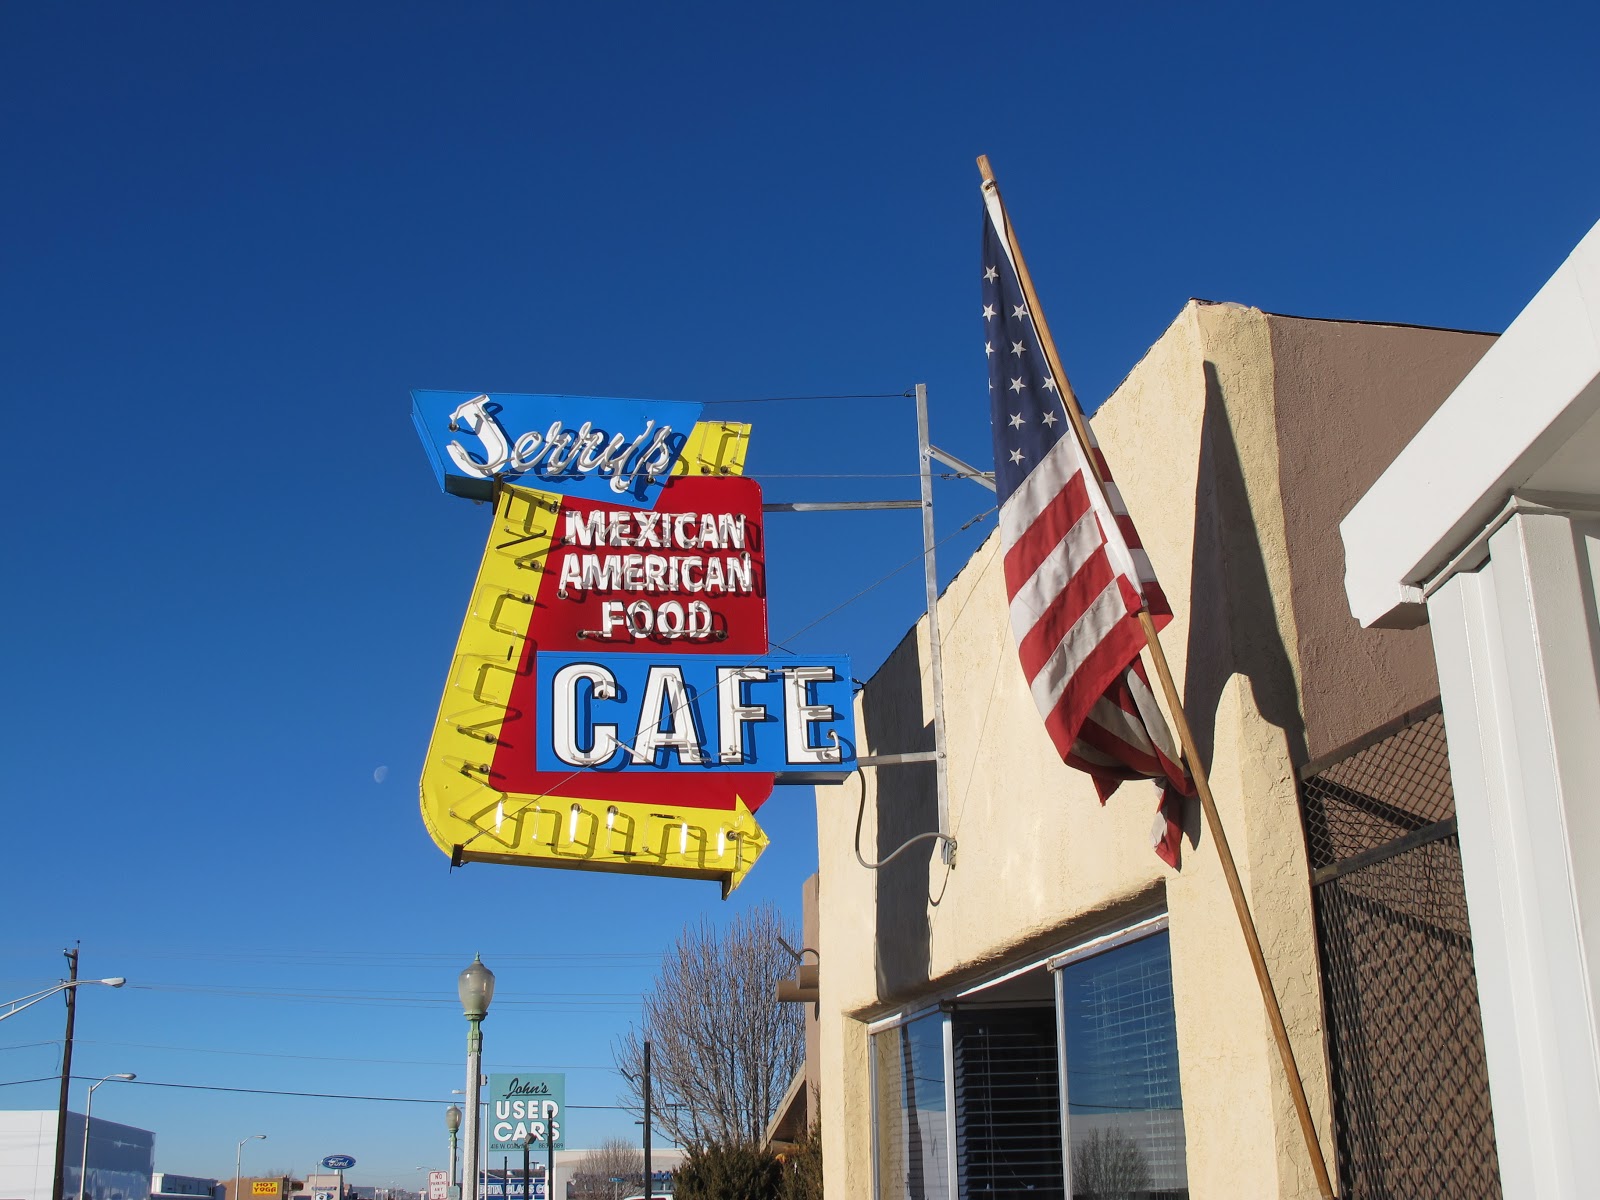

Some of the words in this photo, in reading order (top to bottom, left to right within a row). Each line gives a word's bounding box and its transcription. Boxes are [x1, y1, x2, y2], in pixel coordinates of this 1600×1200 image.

[446, 394, 674, 493] Jerry's
[565, 510, 747, 549] MEXICAN
[558, 553, 753, 592] AMERICAN
[601, 600, 712, 639] FOOD
[552, 662, 842, 766] CAFE
[505, 1077, 549, 1099] John's
[496, 1100, 559, 1120] USED
[493, 1121, 560, 1142] CARS
